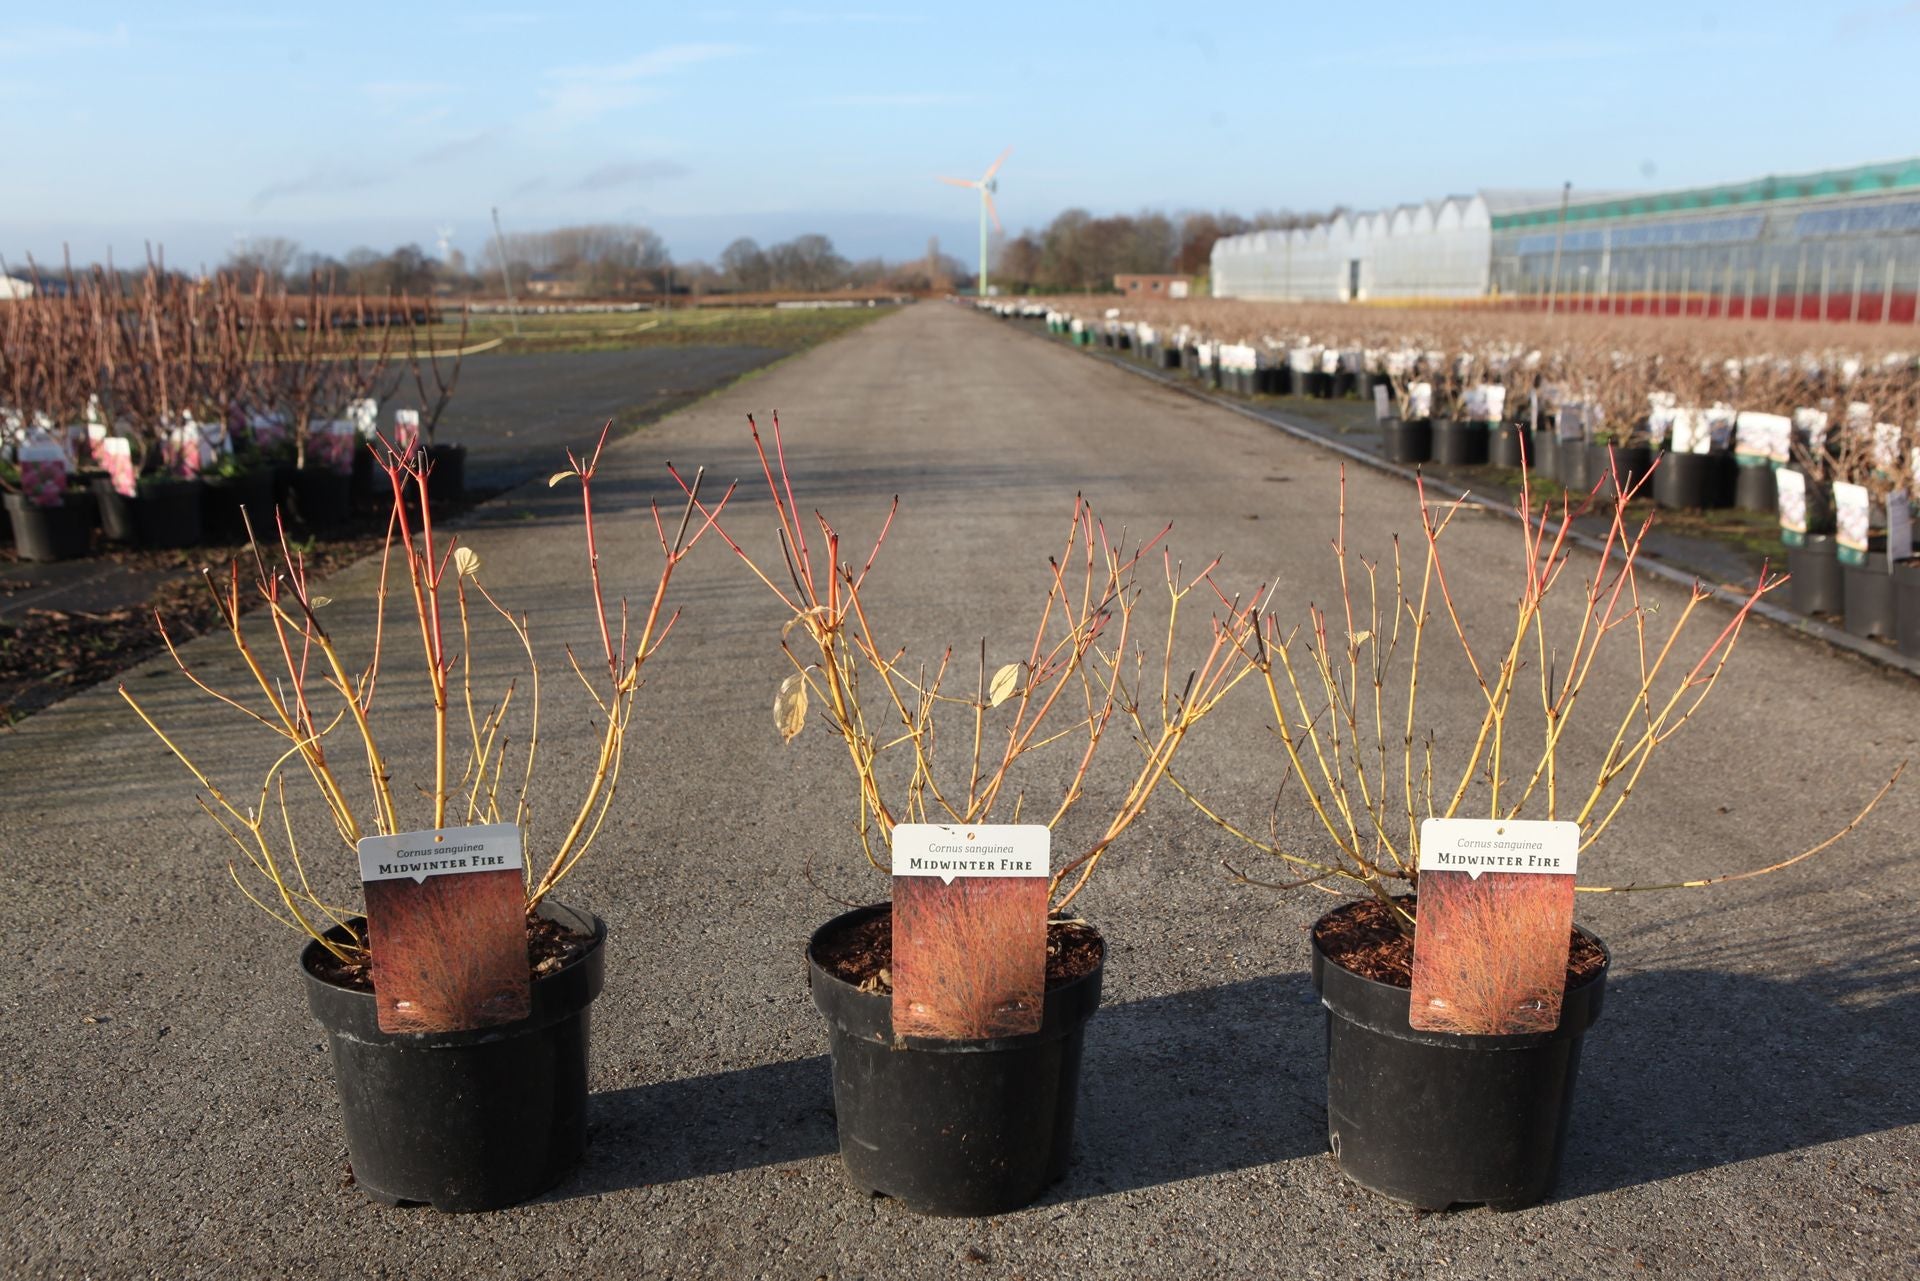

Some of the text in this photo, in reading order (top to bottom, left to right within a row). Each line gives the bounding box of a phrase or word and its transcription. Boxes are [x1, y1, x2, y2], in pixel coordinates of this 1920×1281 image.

[397, 843, 484, 859] Cornus sanguinea
[928, 843, 1014, 856] Cornus sanguinea
[1457, 838, 1543, 852] Cornus sanguinea
[379, 855, 505, 874] MIDWINTER FIRE
[910, 858, 1032, 871] MIDWINTER FIRE
[1437, 852, 1560, 867] MIDWINTER FIRE
